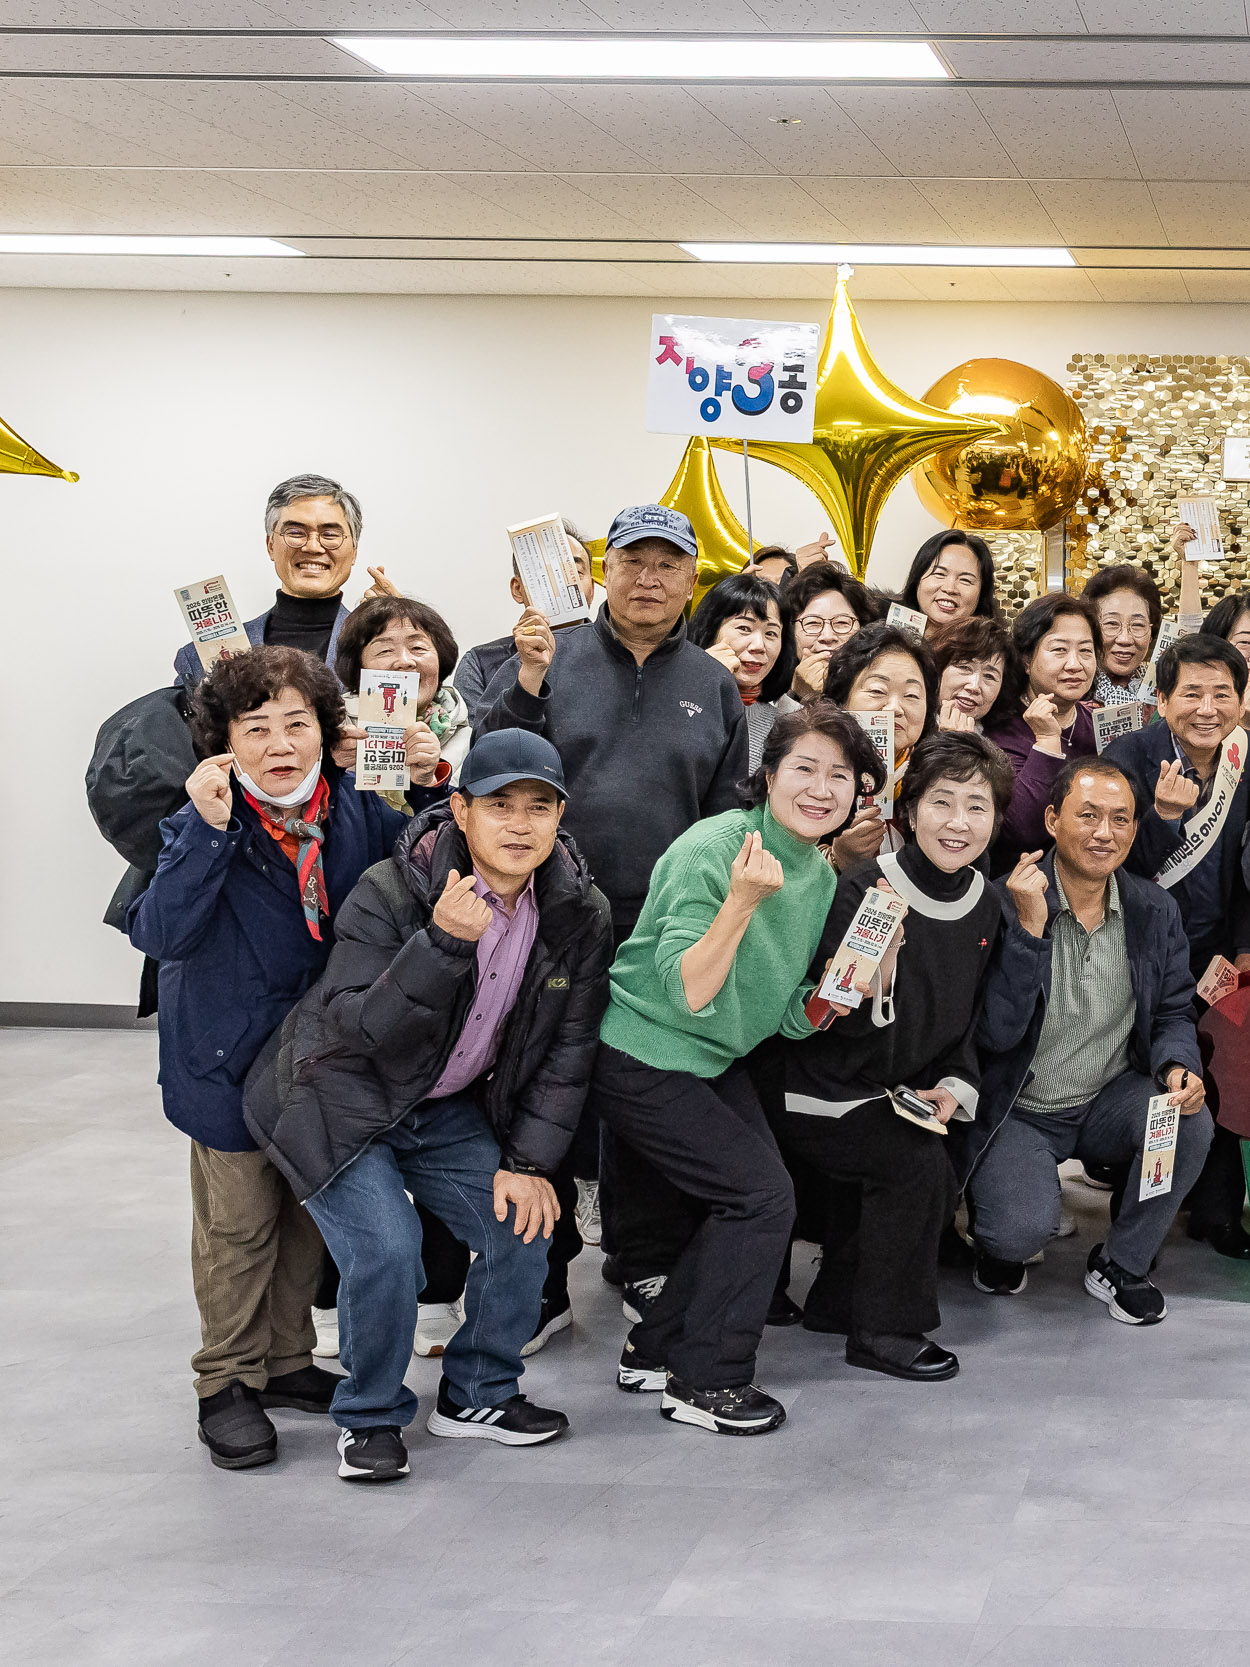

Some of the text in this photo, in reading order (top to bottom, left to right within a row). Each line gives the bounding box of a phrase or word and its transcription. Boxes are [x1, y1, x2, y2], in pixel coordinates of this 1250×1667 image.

[186, 600, 201, 610] 2026
[188, 600, 230, 621] 따뜻한
[193, 611, 233, 630] 겨울나기
[679, 700, 703, 713] GUESS
[1099, 722, 1132, 737] 따뜻한
[363, 750, 406, 763] 따뜻한
[864, 906, 878, 914] 2026
[858, 913, 892, 935] 따뜻한
[853, 926, 887, 944] 겨울나기
[548, 977, 567, 988] K2
[1149, 1115, 1175, 1131] 따뜻한
[1149, 1126, 1174, 1140] 겨울나기
